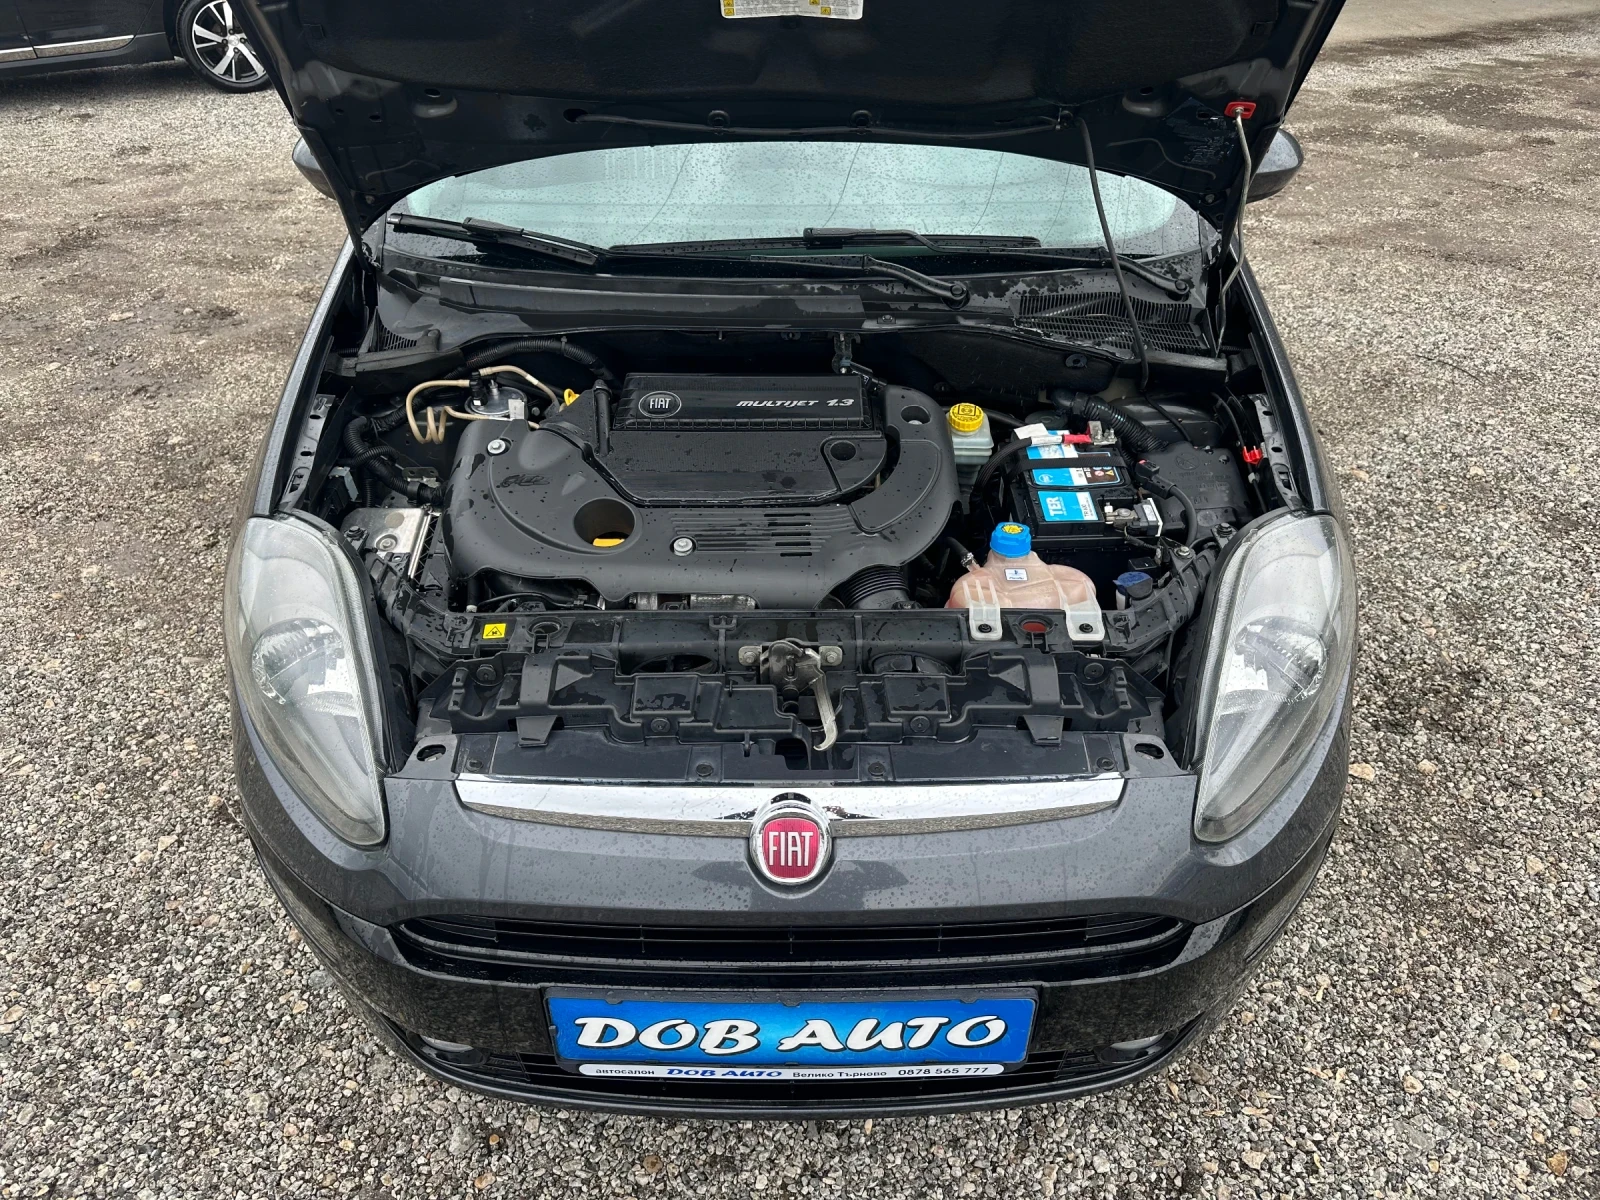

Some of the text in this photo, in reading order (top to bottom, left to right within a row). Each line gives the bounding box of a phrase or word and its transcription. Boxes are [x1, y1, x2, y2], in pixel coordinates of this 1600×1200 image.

[649, 398, 671, 409] FIAT
[736, 398, 855, 408] MULTIJET 1.3
[1046, 496, 1065, 517] TER
[768, 831, 814, 867] FIAT
[574, 1015, 1010, 1055] DOB AUTO
[666, 1068, 716, 1077] DOB
[721, 1069, 783, 1078] AUTO
[837, 1070, 887, 1078] Търново
[898, 1067, 931, 1076] 0878
[934, 1067, 960, 1075] 565
[964, 1066, 989, 1074] 777
